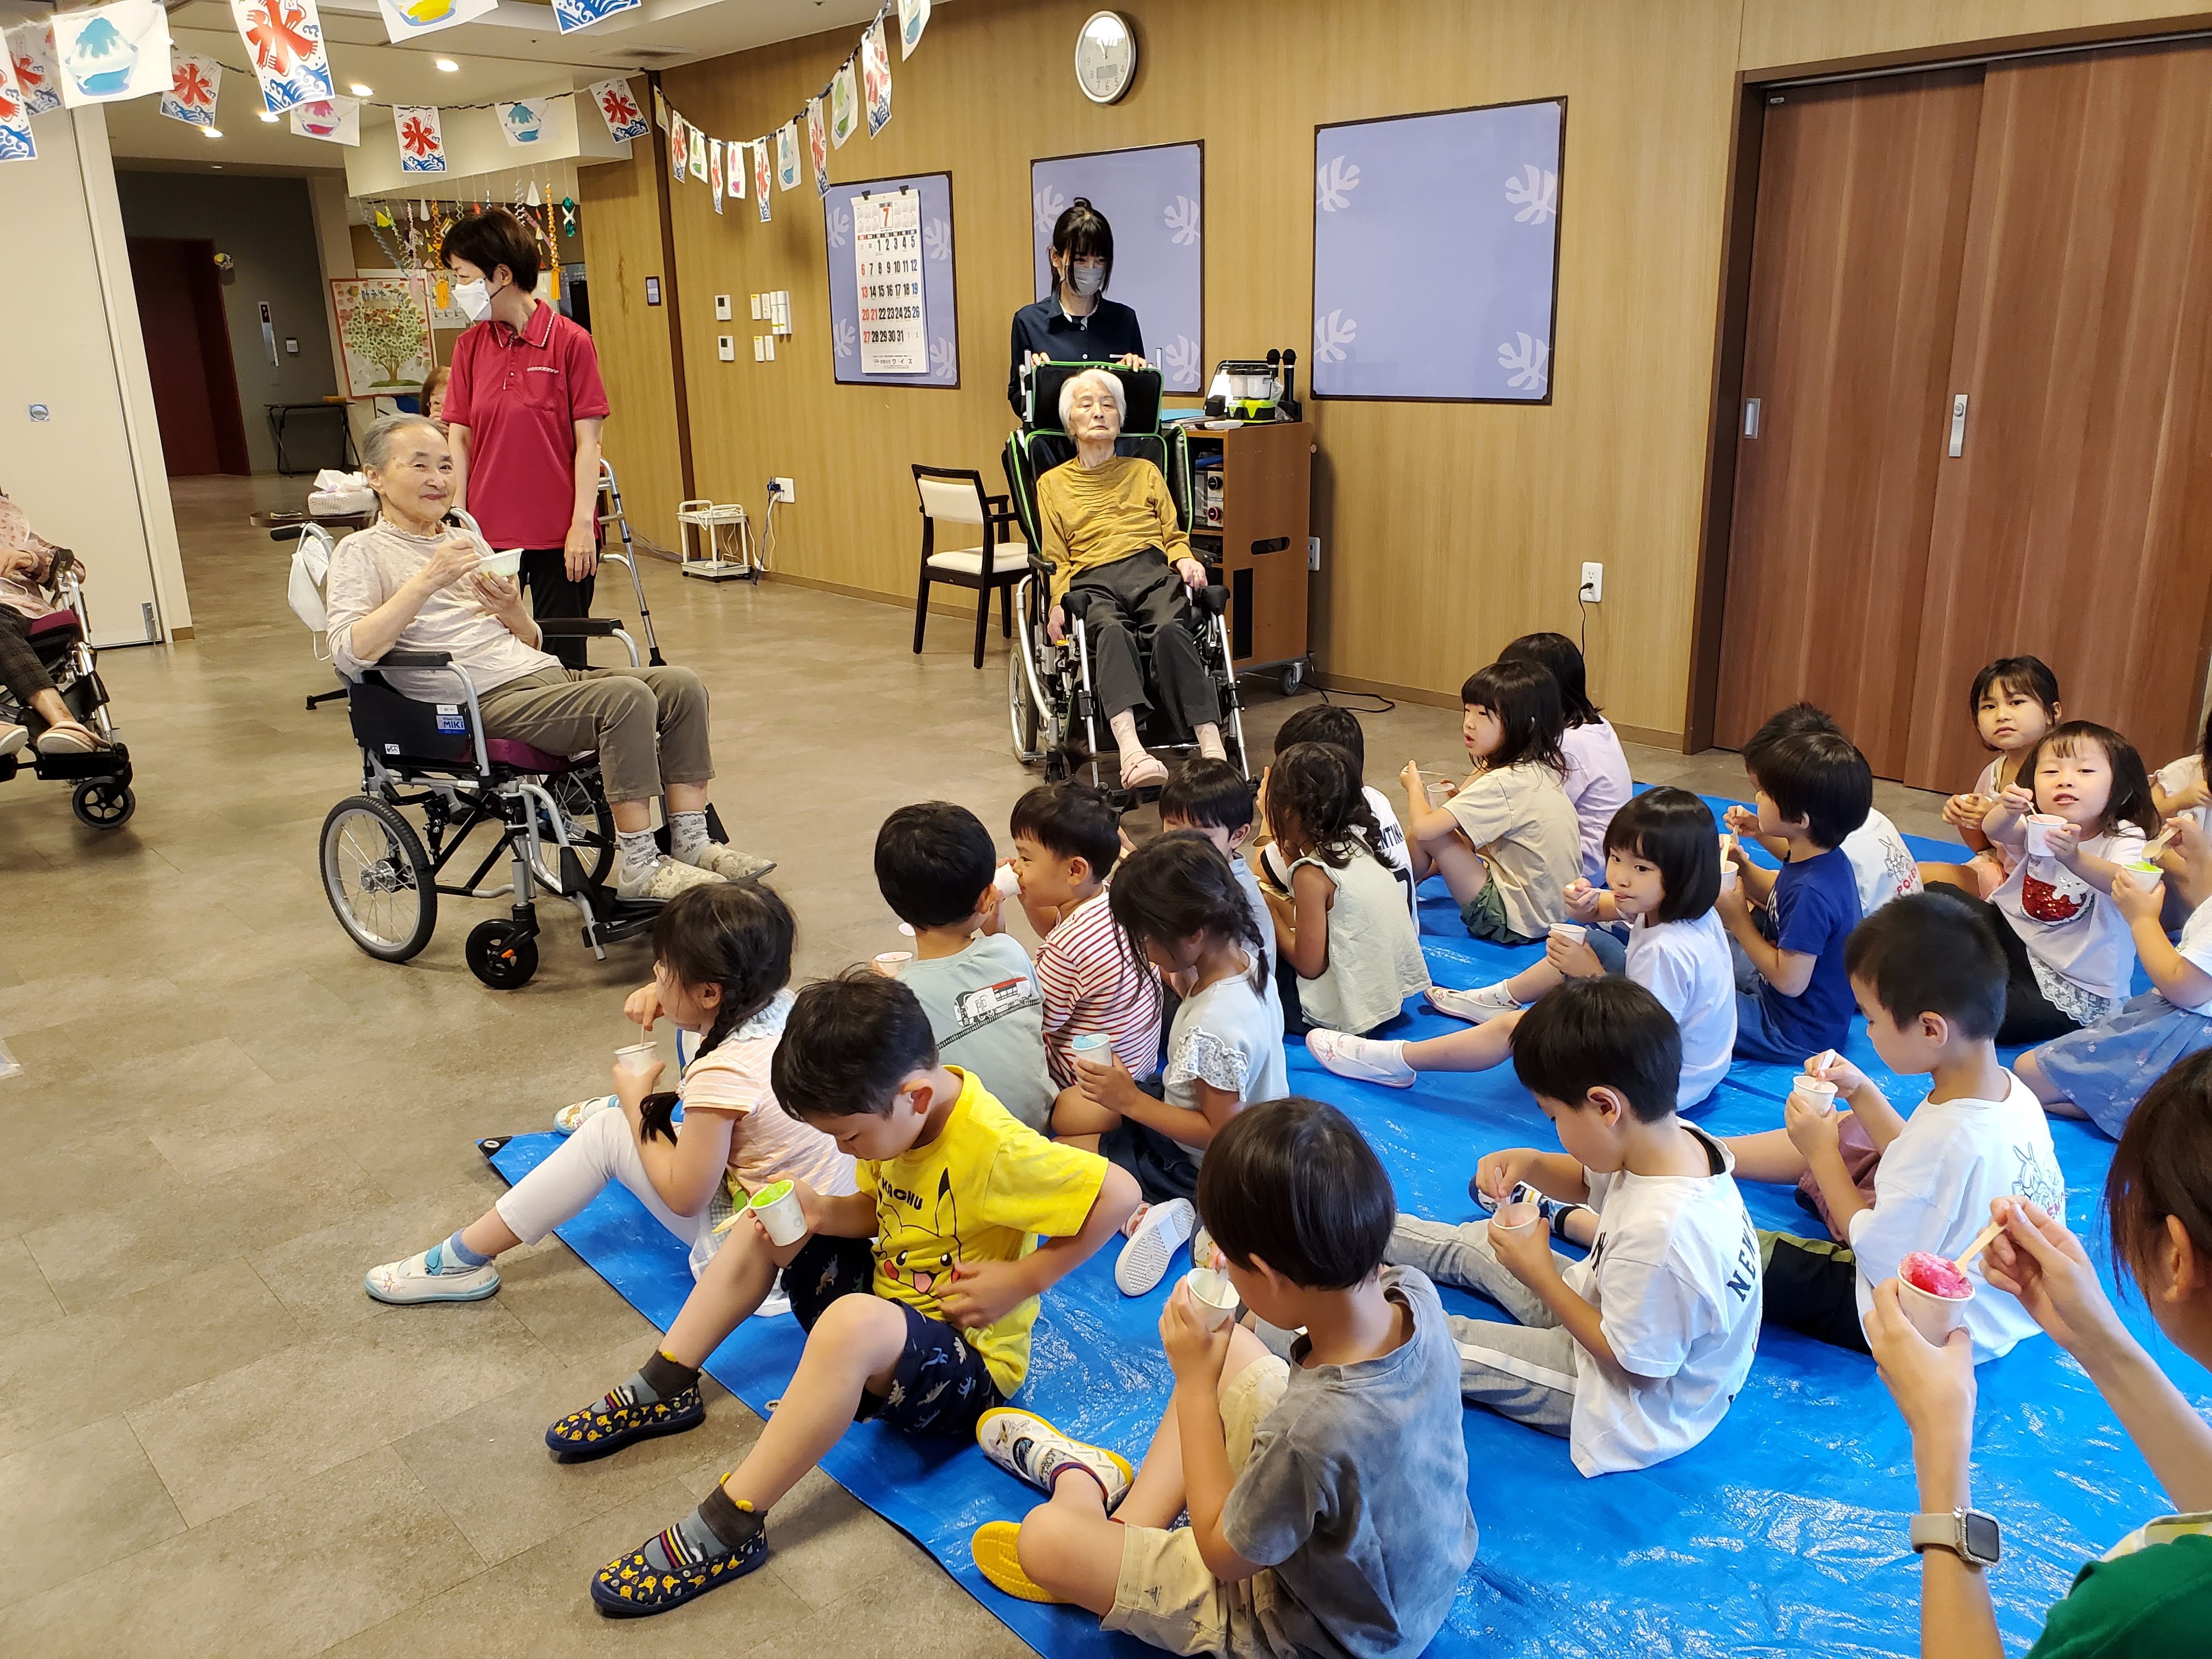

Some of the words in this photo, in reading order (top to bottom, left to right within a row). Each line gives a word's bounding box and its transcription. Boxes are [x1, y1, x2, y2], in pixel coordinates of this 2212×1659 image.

[246, 0, 318, 77] 氷
[1090, 70, 1094, 78] 8
[170, 63, 214, 106] 氷
[1096, 81, 1101, 89] 7
[1105, 82, 1109, 91] 6
[1115, 78, 1119, 87] 5
[602, 90, 638, 126] 氷
[401, 116, 441, 158] 氷
[883, 207, 889, 227] 7
[878, 239, 881, 251] 1
[885, 239, 890, 251] 2
[894, 238, 898, 250] 3
[902, 236, 906, 249] 4
[911, 235, 915, 248] 5
[861, 263, 865, 275] 6
[870, 263, 873, 275] 7
[878, 262, 882, 274] 8
[887, 261, 890, 273] 9
[894, 261, 900, 273] 10
[902, 259, 909, 272] 11
[911, 259, 917, 272] 12
[861, 286, 868, 298] 13
[870, 285, 876, 297] 14
[878, 285, 884, 297] 15
[887, 284, 893, 296] 16
[895, 284, 901, 296] 17
[903, 283, 910, 295] 18
[911, 283, 918, 295] 19
[862, 309, 869, 320] 20
[871, 308, 877, 320] 21
[879, 308, 886, 320] 22
[887, 307, 894, 319] 23
[895, 307, 902, 319] 24
[904, 306, 911, 318] 25
[912, 306, 919, 318] 26
[864, 331, 870, 343] 27
[872, 331, 879, 342] 28
[880, 330, 887, 342] 29
[888, 330, 895, 342] 30
[897, 330, 904, 342] 31
[1378, 822, 1404, 849] NTINA
[879, 1171, 923, 1210] KACHU
[1726, 1227, 1756, 1302] NEW
